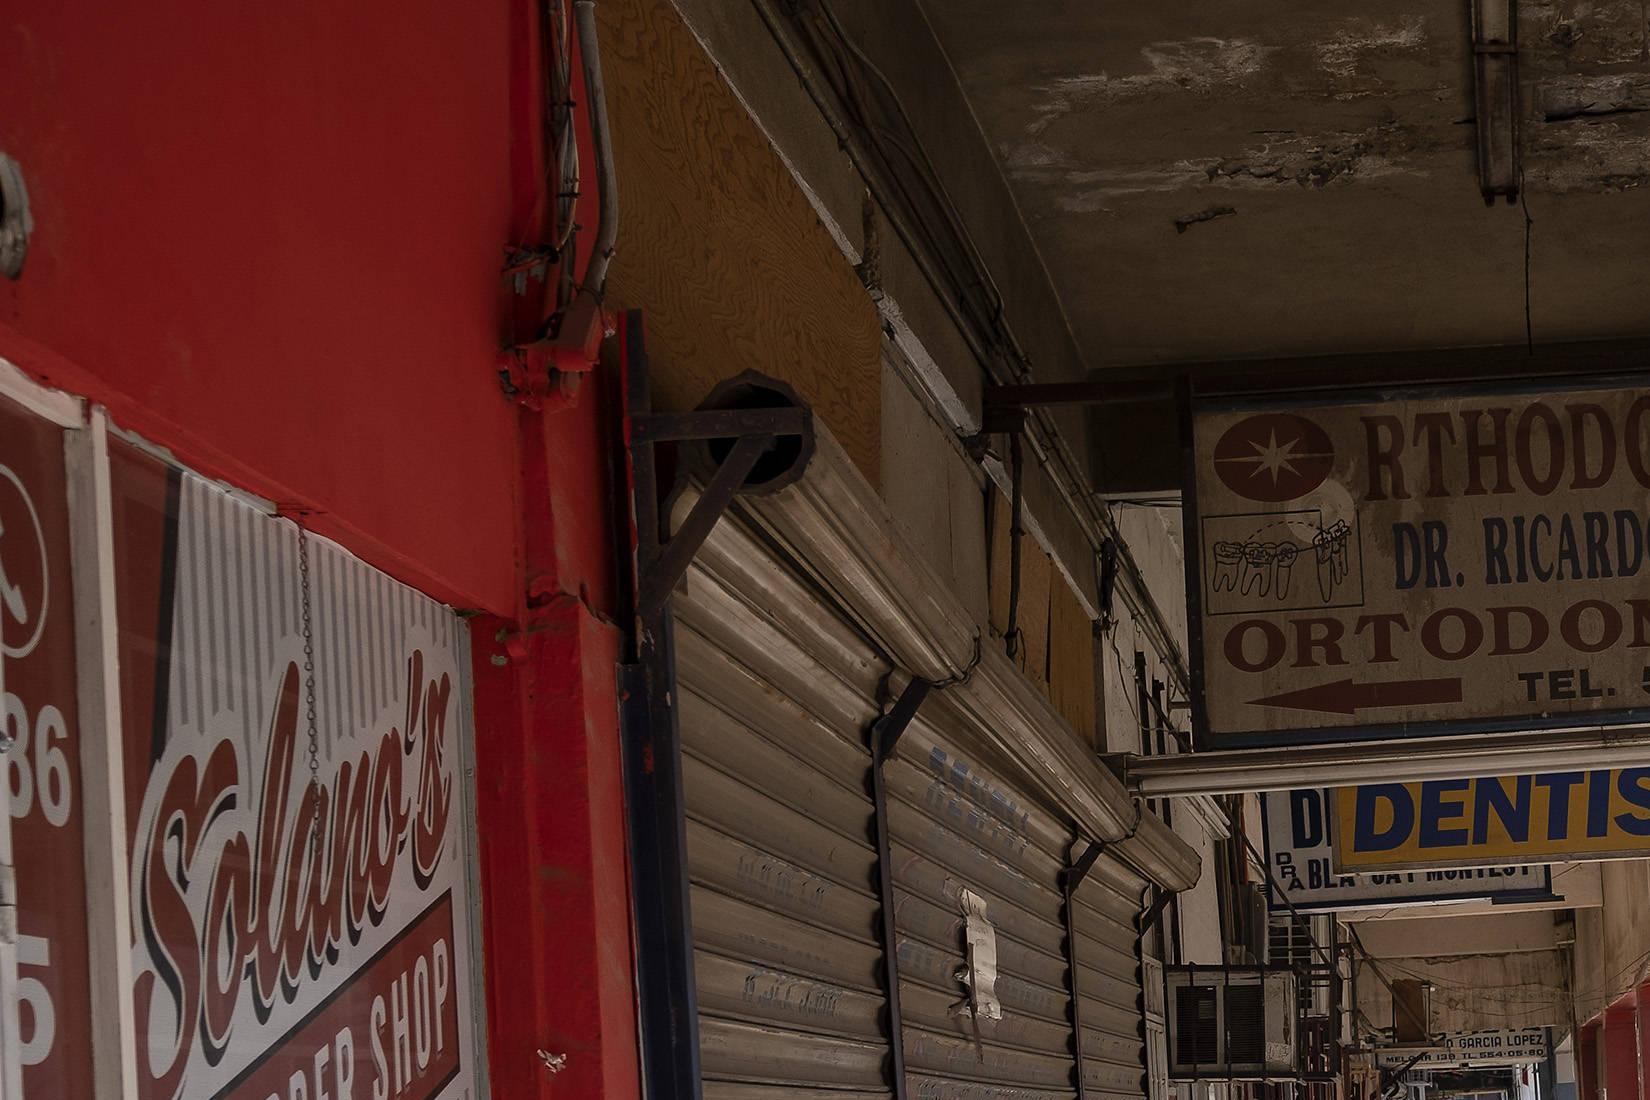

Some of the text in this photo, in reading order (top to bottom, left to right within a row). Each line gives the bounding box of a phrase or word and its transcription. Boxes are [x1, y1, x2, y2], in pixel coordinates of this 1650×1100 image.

[1392, 519, 1464, 591] DR.
[1517, 668, 1616, 702] TEL.
[1460, 1036, 1502, 1049] GARCIA
[1507, 1034, 1543, 1046] LOPEZ
[1386, 1053, 1431, 1063] MELR
